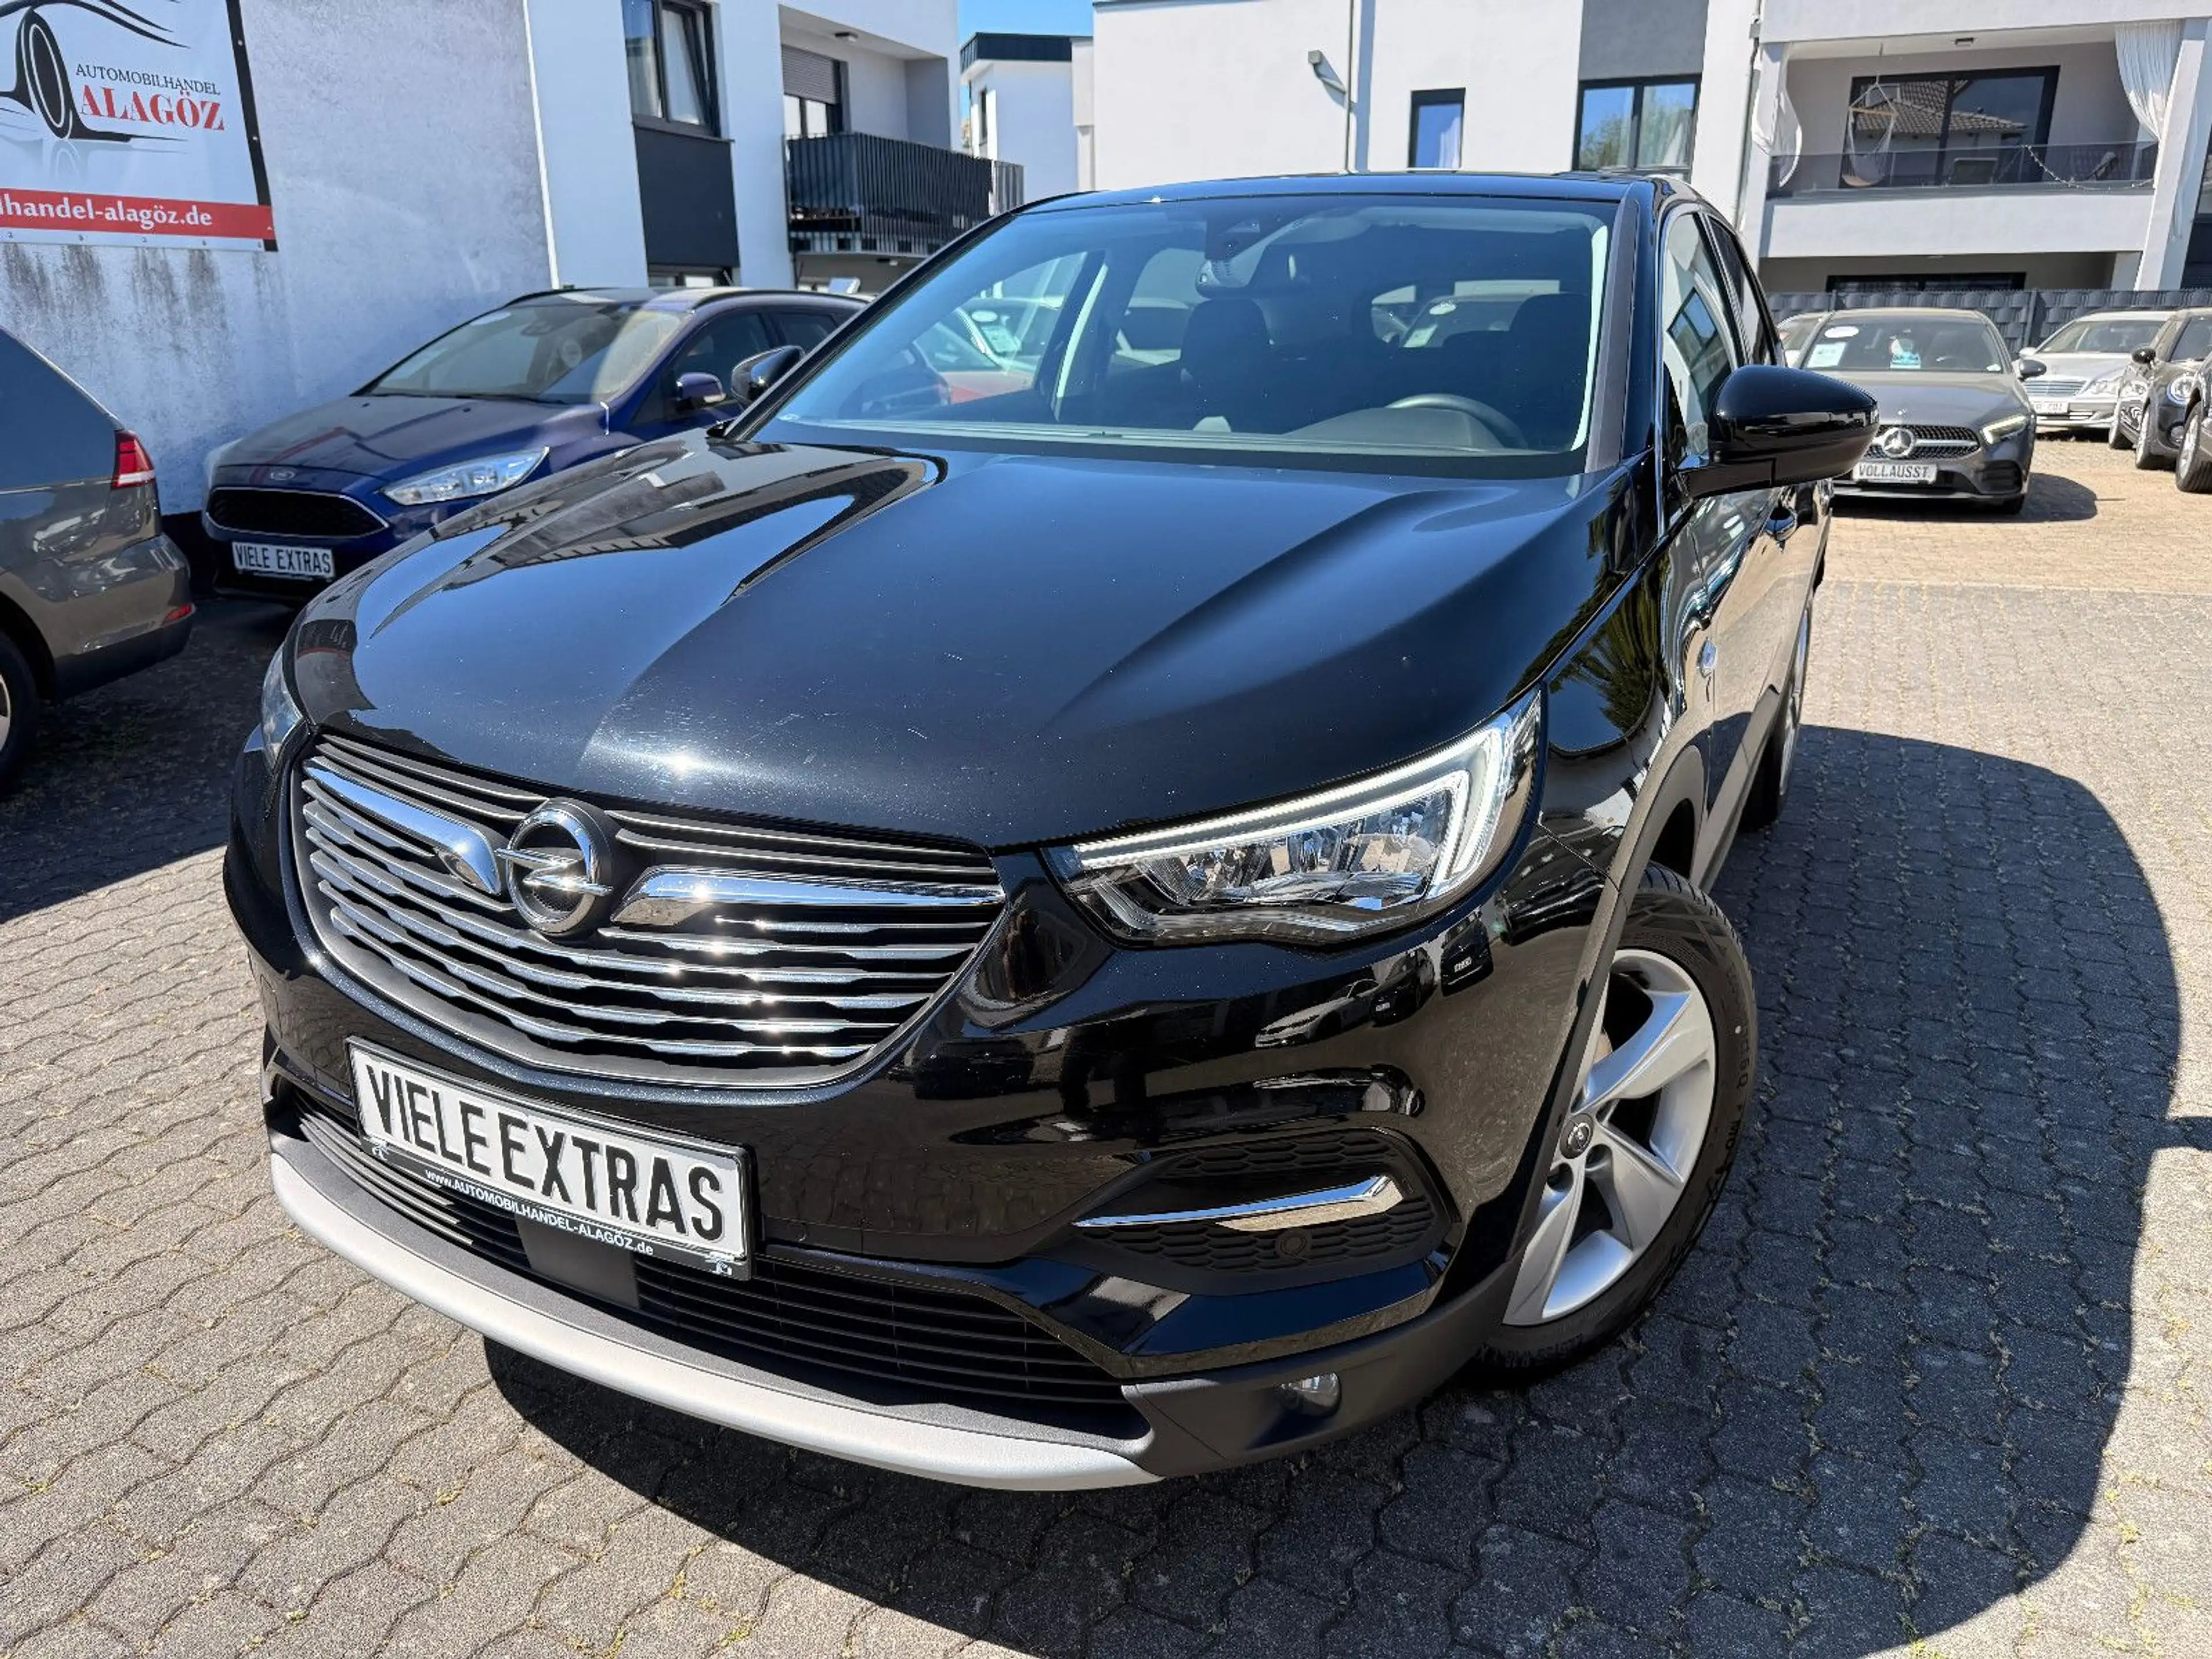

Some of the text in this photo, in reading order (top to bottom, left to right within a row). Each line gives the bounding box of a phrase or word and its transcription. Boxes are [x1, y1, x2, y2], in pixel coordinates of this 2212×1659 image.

[75, 63, 221, 95] AUTOMOBILHANDEL
[79, 84, 225, 131] ALAGÖZ
[235, 544, 331, 574] VIELE EXTRAS
[366, 1064, 724, 1241] VIELE EXTRAS
[425, 1169, 654, 1256] www.AUTOMOBILHANDEL-ALAGÖZ.de
